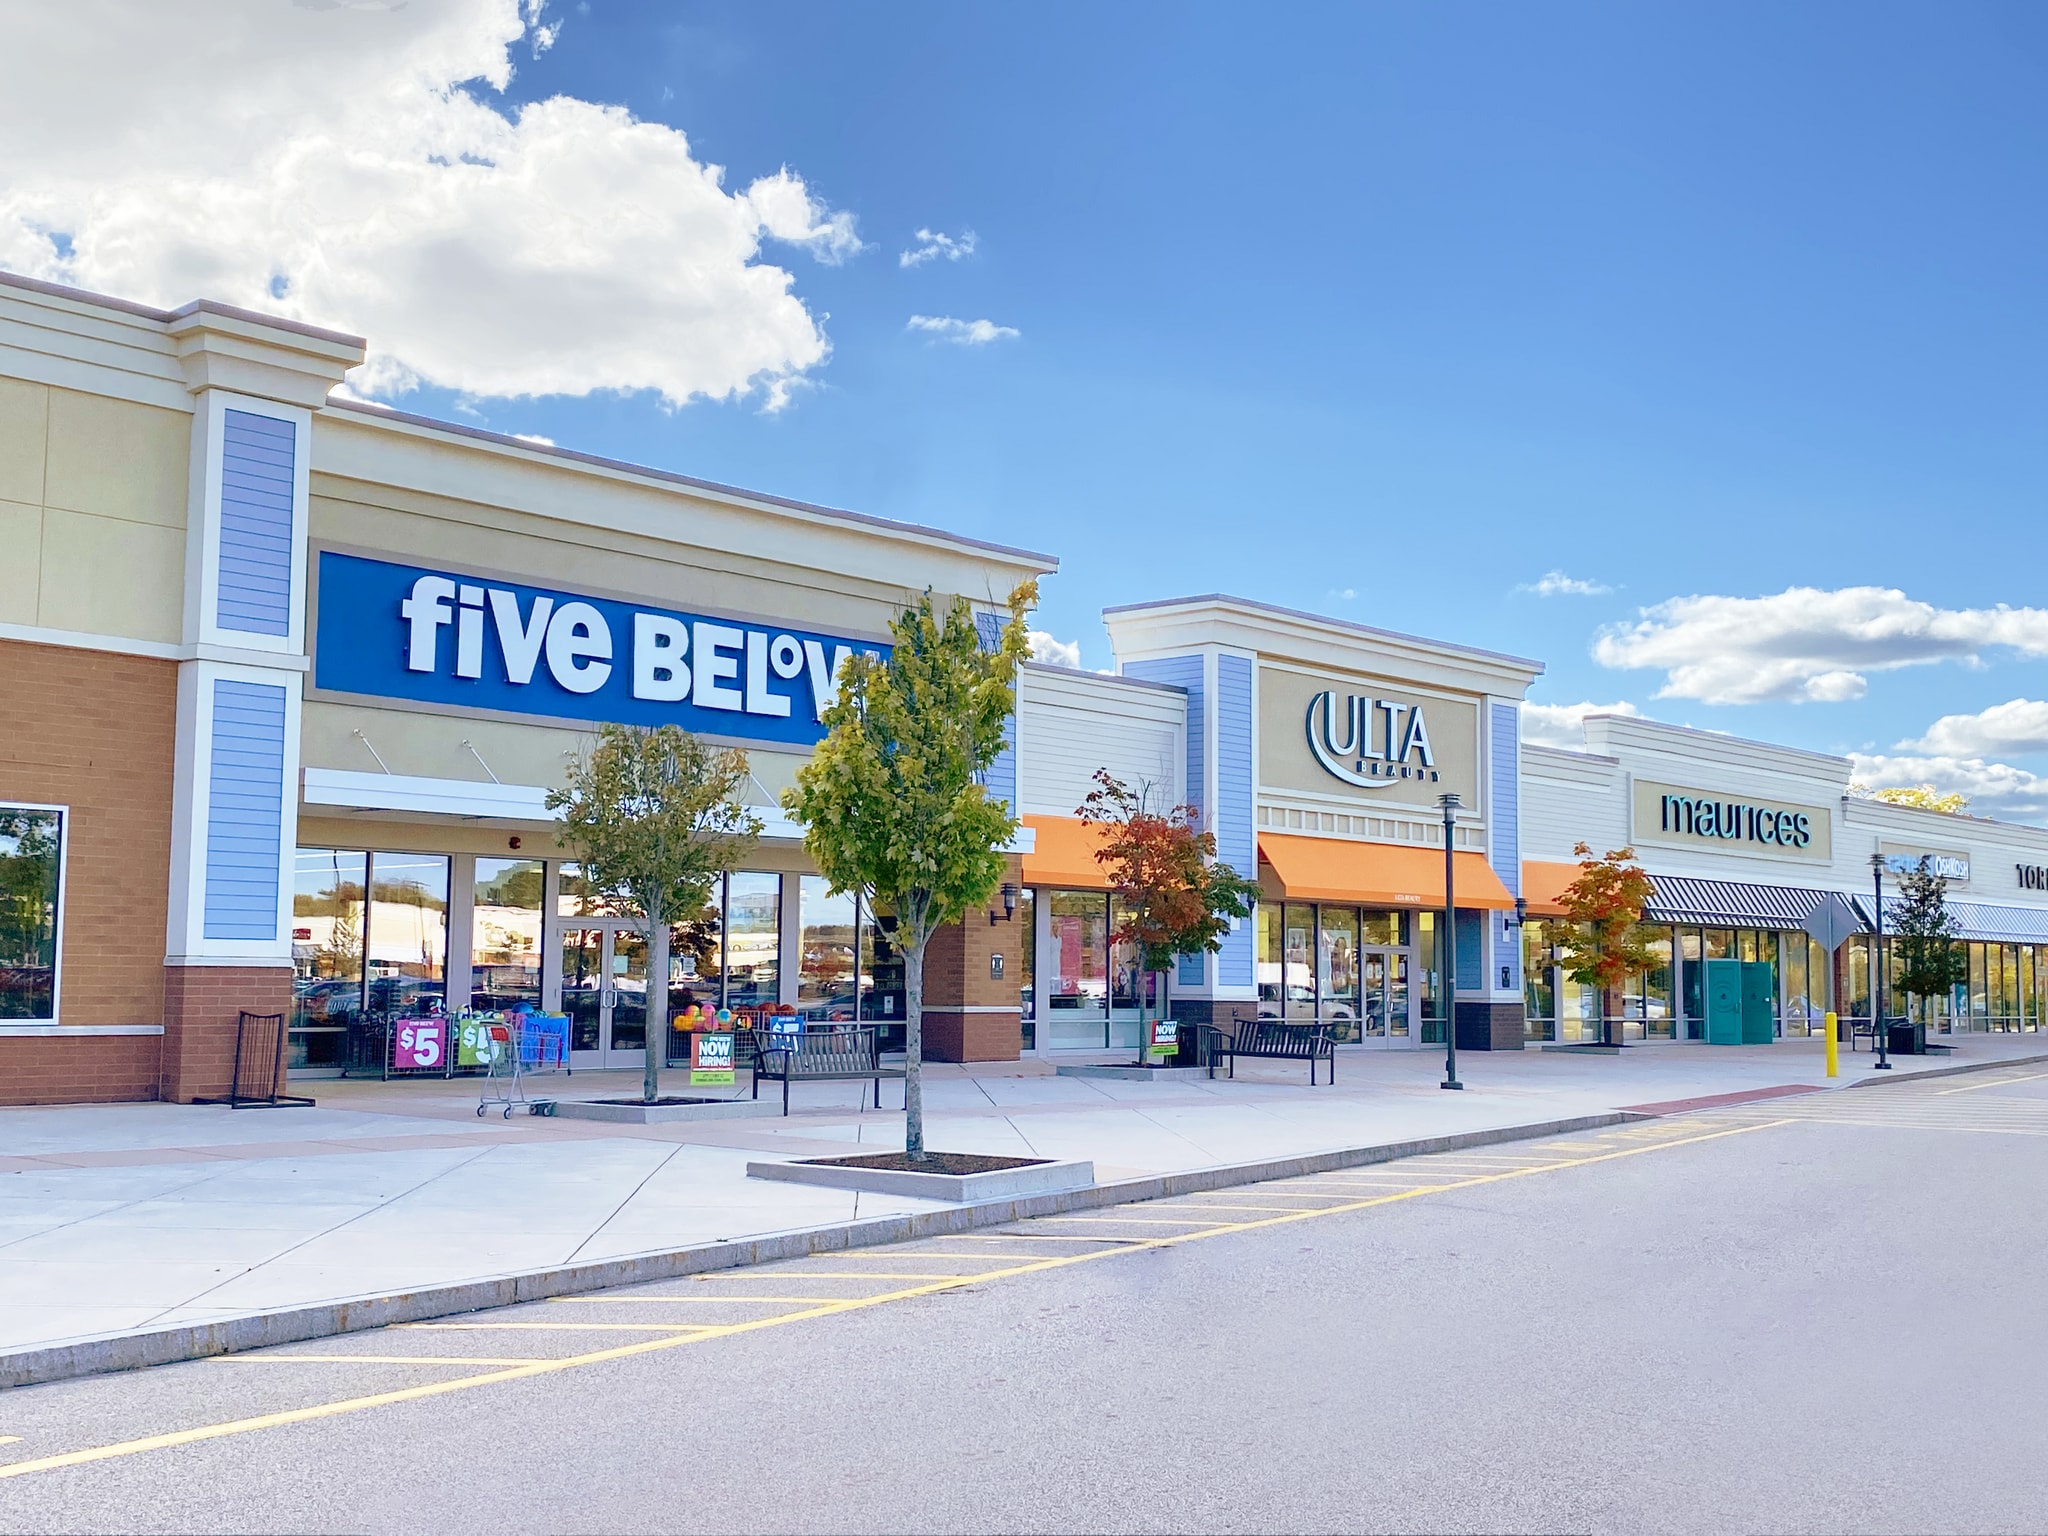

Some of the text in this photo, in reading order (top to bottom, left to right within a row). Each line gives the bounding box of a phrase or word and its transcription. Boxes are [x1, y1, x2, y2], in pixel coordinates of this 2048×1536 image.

[1323, 691, 1434, 766] ULTA
[1356, 760, 1441, 783] BEAUTY
[1661, 795, 1811, 848] maurices
[2015, 863, 2048, 891] TOR
[1155, 1024, 1177, 1034] NOW
[400, 1026, 440, 1066] $5
[698, 1041, 731, 1056] NOW
